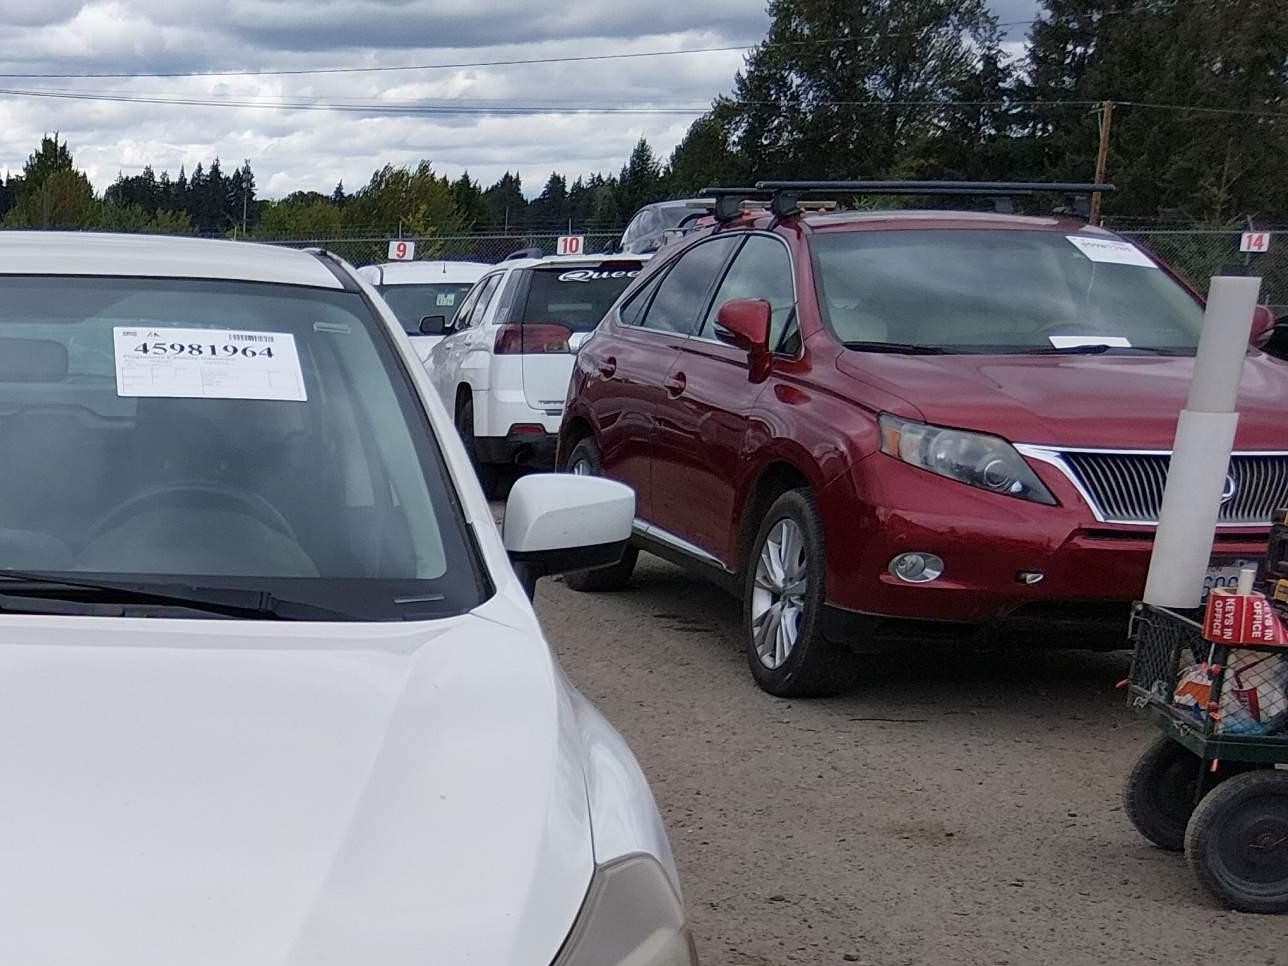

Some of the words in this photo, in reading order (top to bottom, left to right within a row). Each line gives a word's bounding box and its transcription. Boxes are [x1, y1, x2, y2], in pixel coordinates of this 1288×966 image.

[396, 242, 408, 258] 9
[562, 237, 579, 254] 10
[1246, 234, 1265, 251] 14
[133, 342, 275, 359] 45981964
[1212, 600, 1223, 636] OFFICE
[1224, 598, 1236, 626] KEYS
[1251, 601, 1262, 638] OFFICE
[1223, 628, 1233, 640] IN
[1264, 629, 1273, 640] IN
